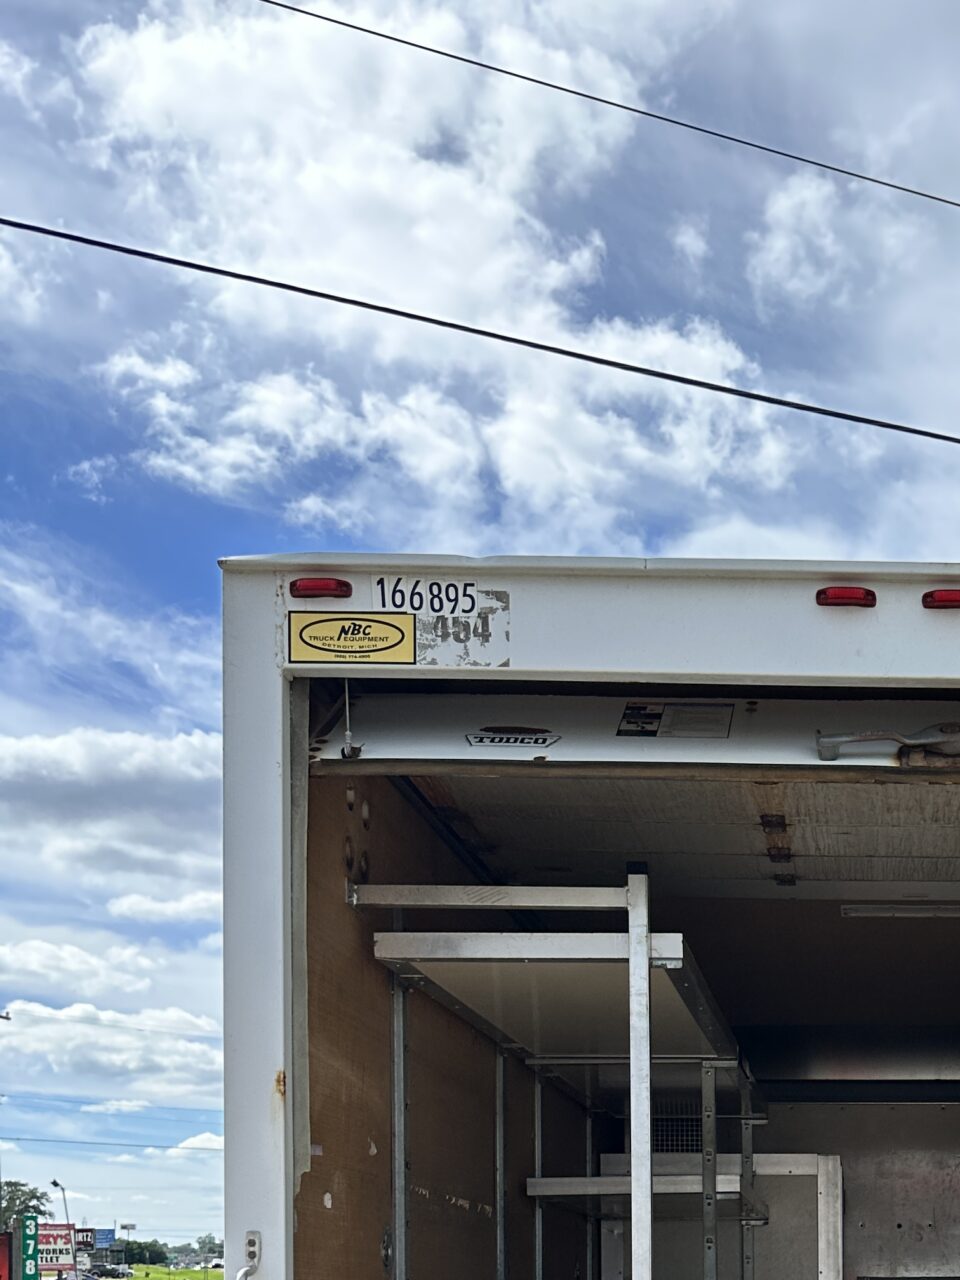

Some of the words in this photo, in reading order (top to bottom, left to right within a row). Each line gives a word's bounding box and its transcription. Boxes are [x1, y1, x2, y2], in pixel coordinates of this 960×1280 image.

[376, 577, 476, 614] 166895
[336, 622, 372, 641] NBC
[343, 635, 390, 643] EQUIPMENT
[474, 736, 548, 745] TODCO
